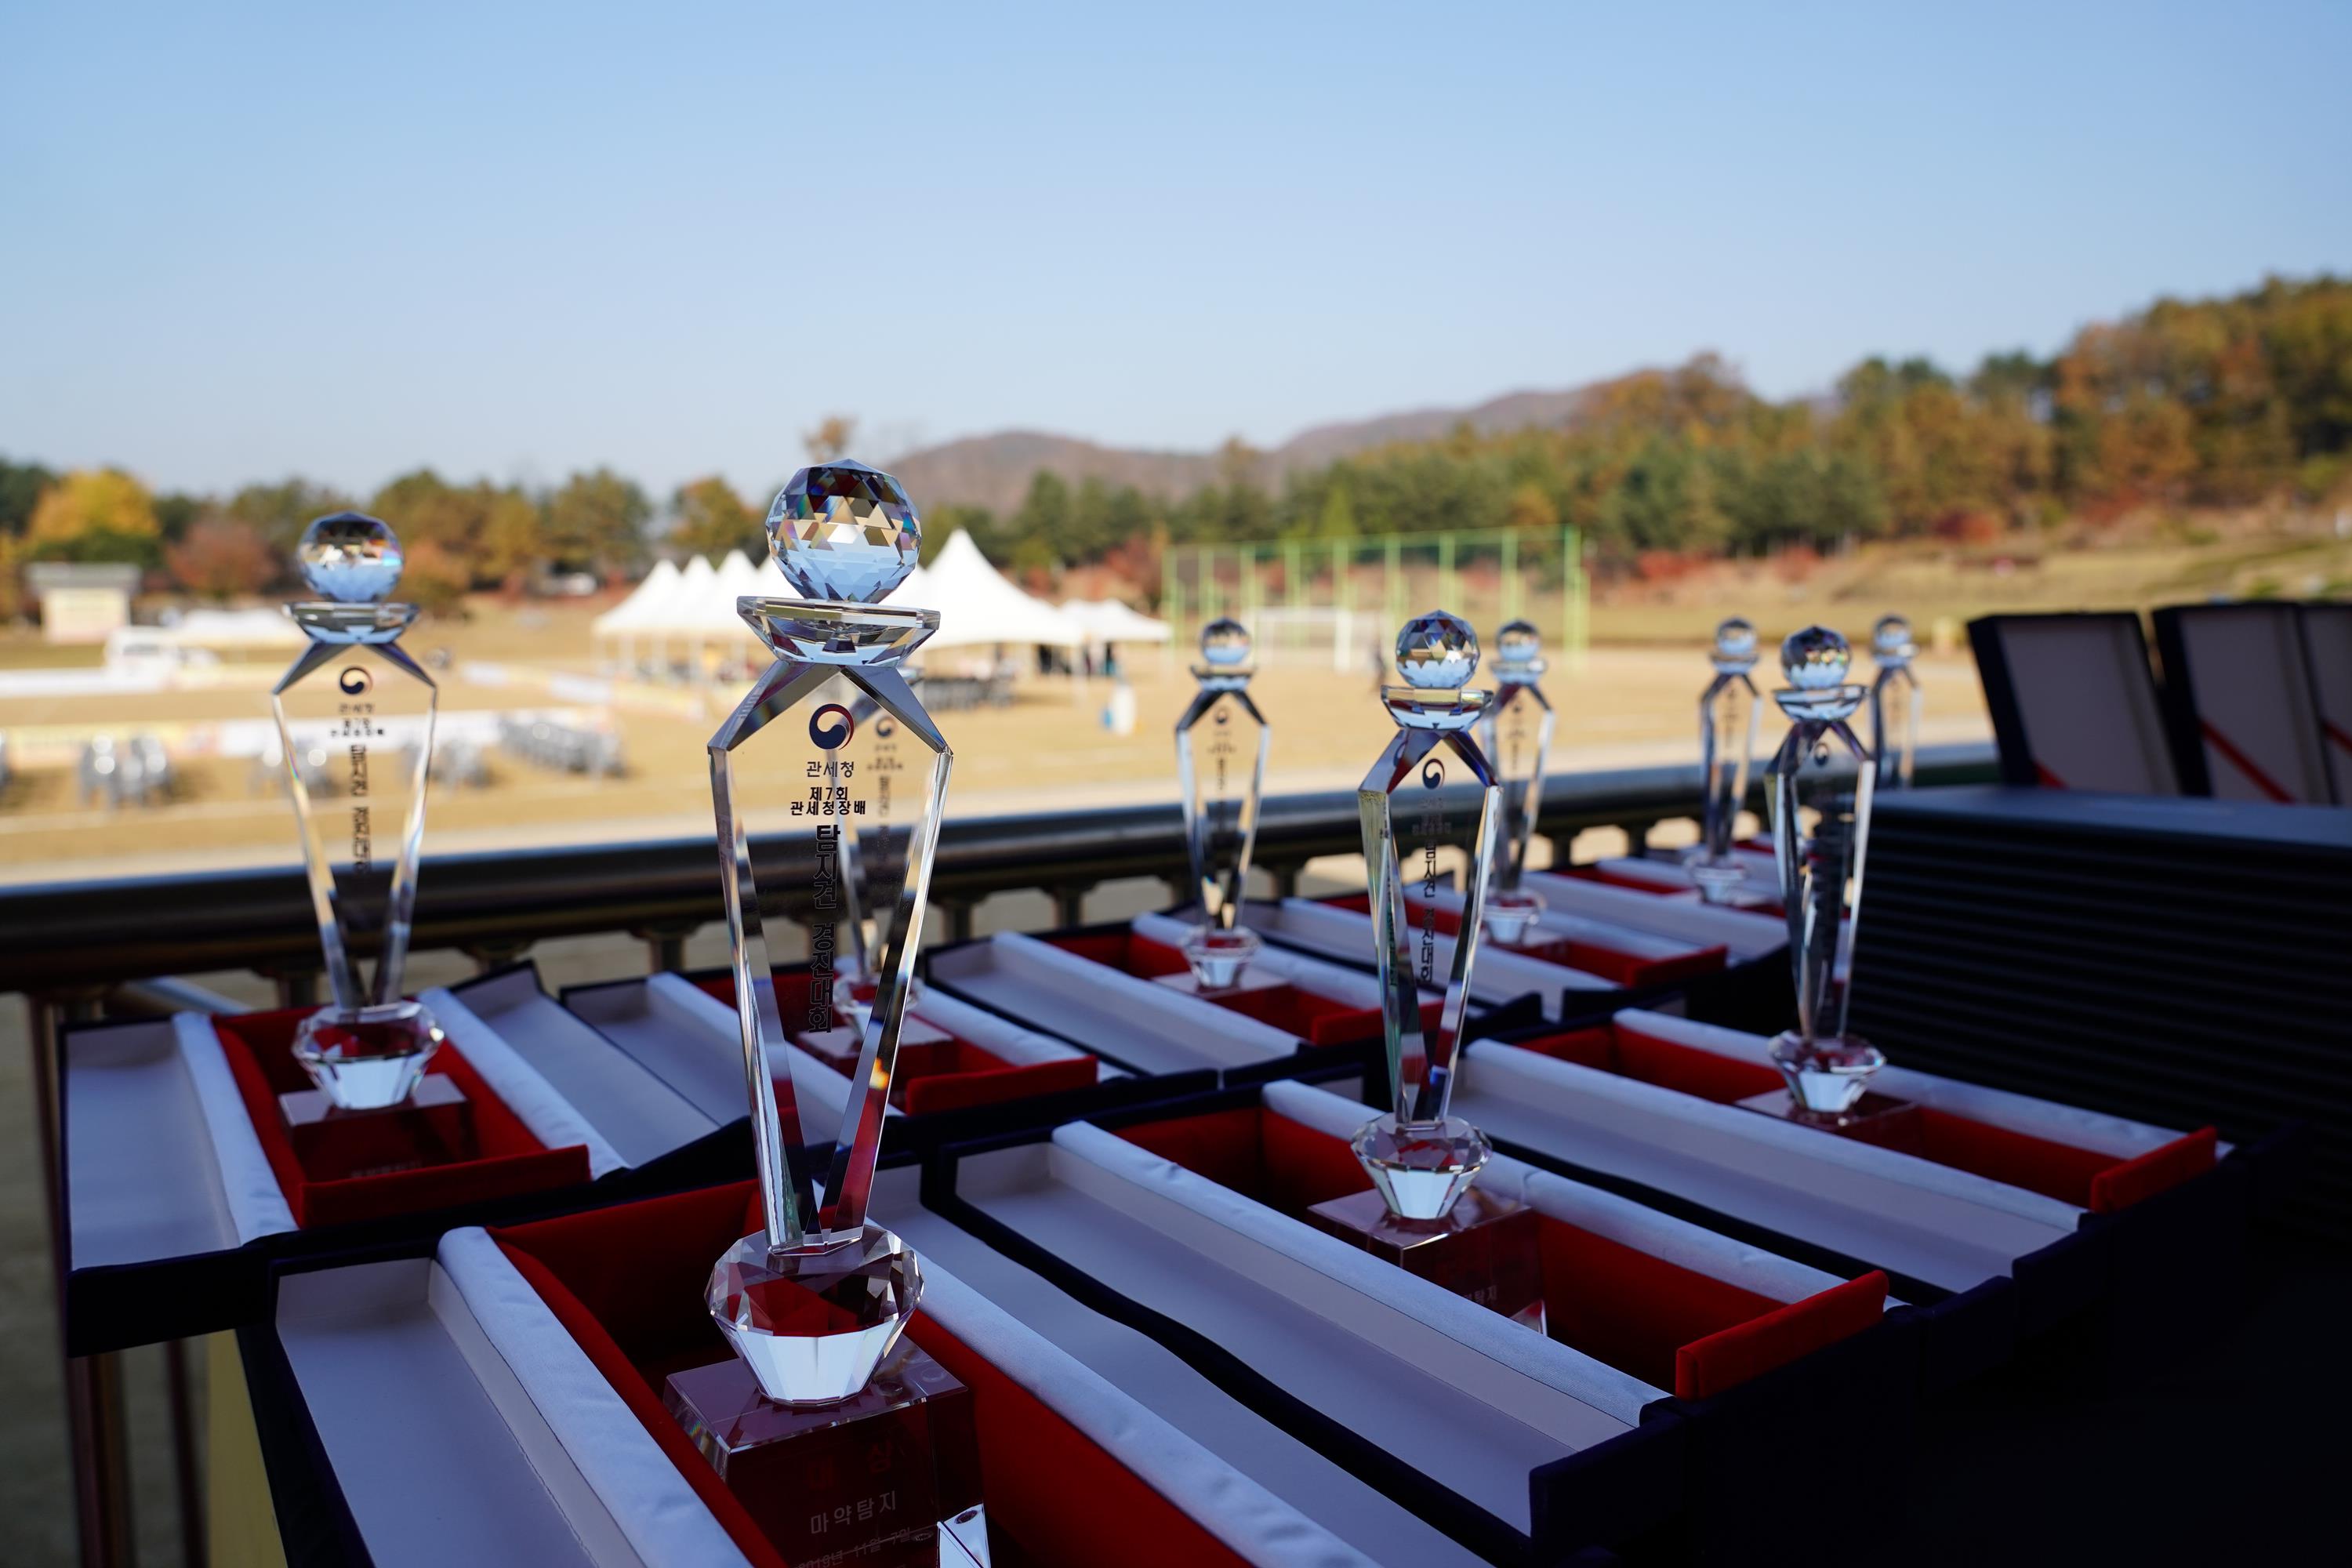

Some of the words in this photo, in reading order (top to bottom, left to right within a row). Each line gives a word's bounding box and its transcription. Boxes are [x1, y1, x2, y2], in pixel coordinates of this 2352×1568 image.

[806, 761, 855, 779] 관세청
[789, 800, 866, 816] 관세청장배
[809, 786, 849, 802] 제7회
[813, 824, 841, 909] 탐지견
[808, 922, 836, 1034] 경진대회
[809, 1490, 897, 1535] 마약탐지
